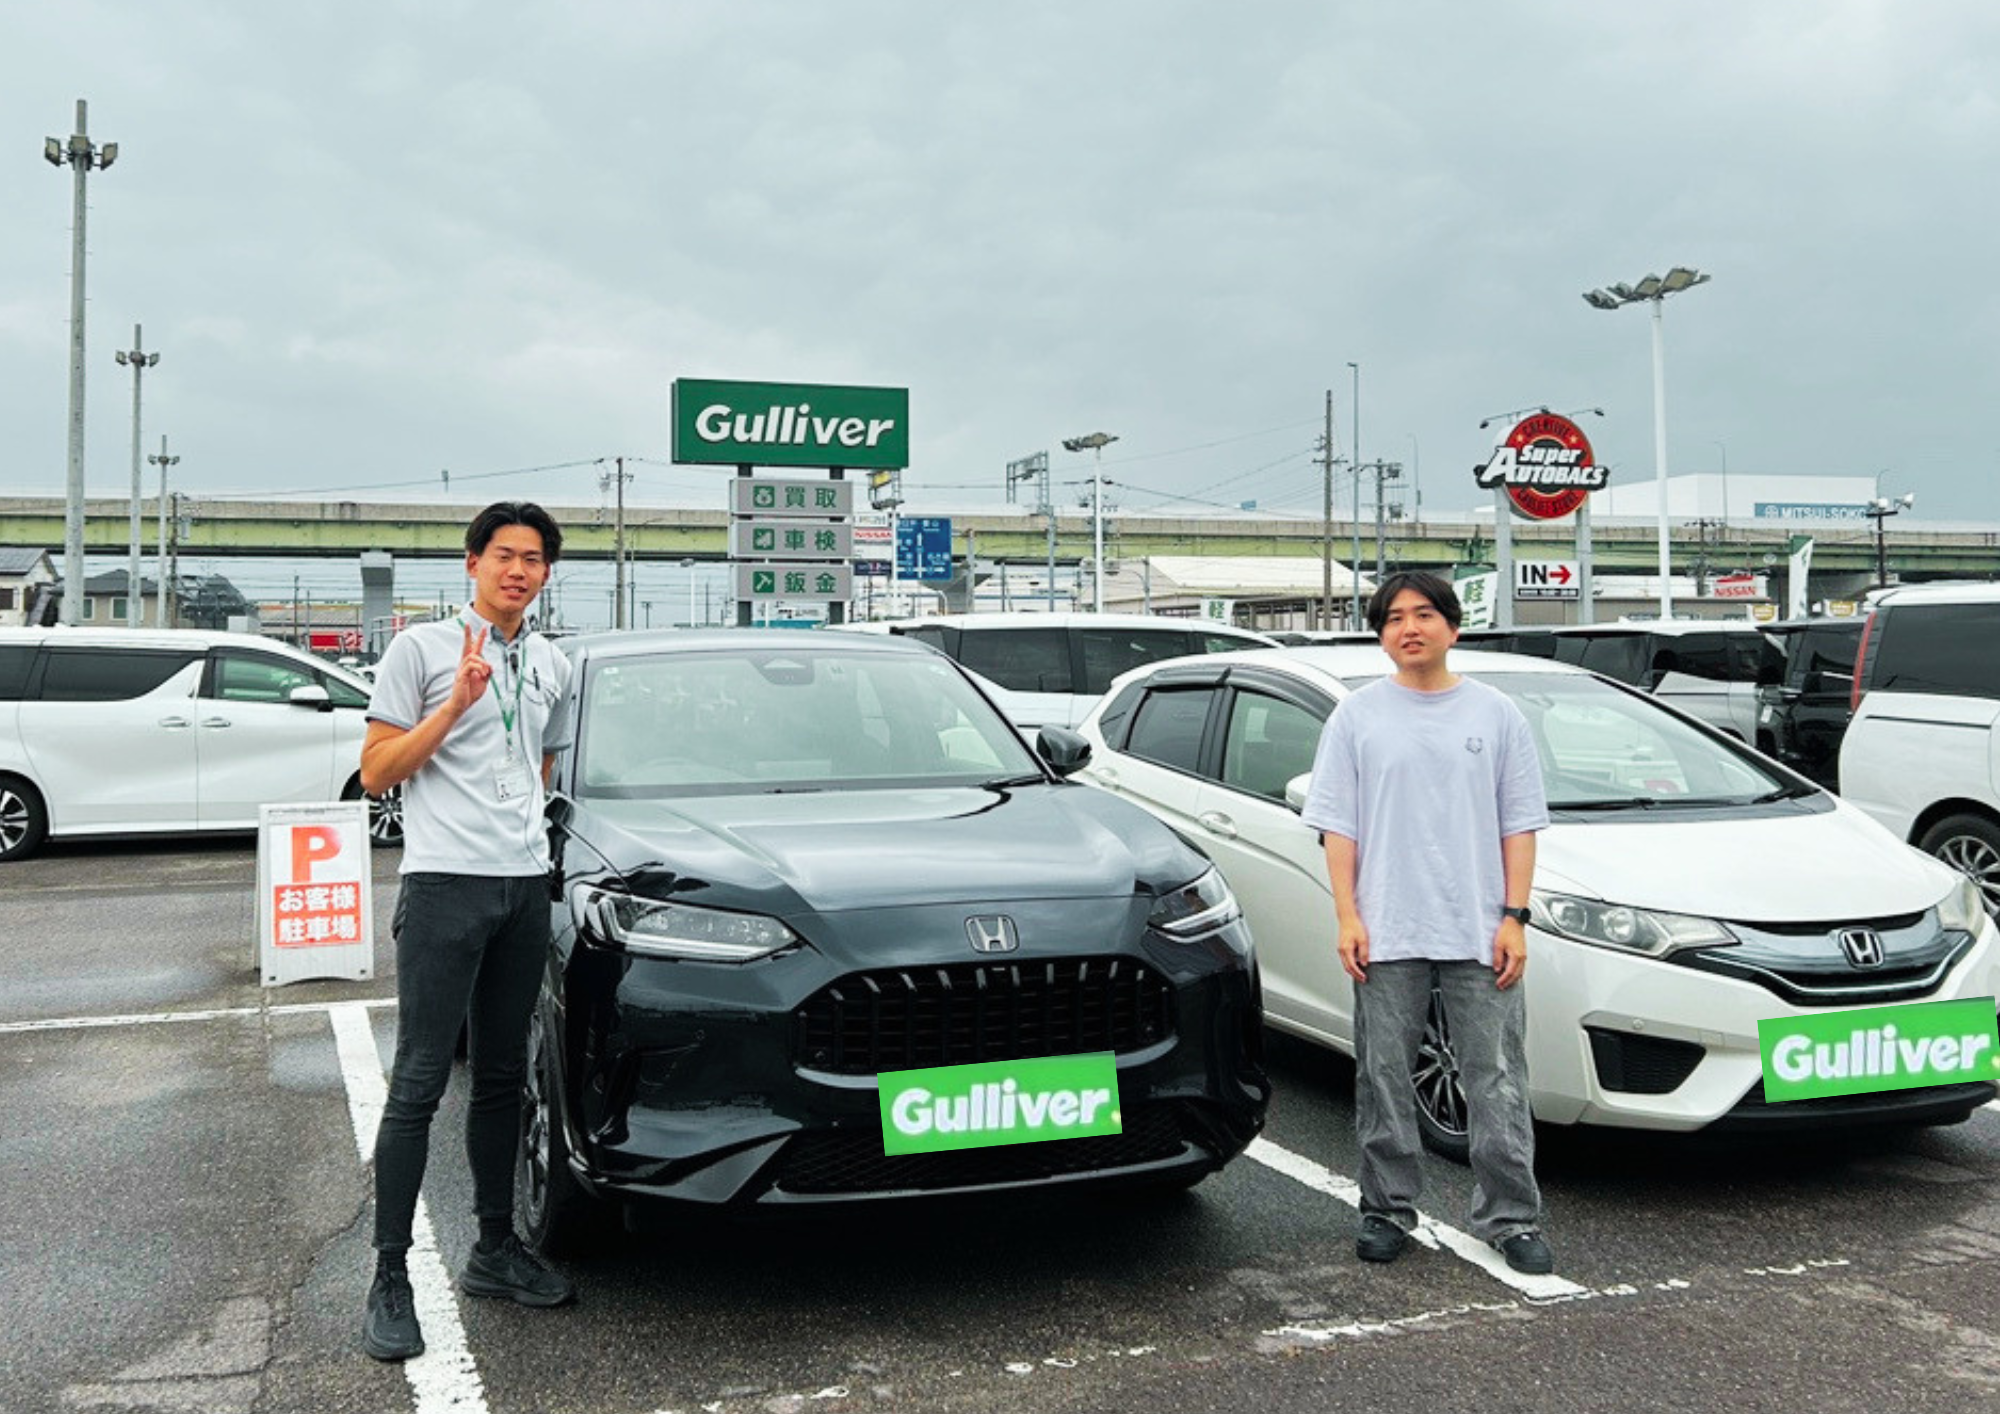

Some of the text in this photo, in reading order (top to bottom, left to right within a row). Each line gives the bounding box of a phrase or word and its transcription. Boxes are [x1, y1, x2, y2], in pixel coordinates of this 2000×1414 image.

[695, 403, 894, 446] Gulliver
[1480, 446, 1604, 485] AUTOBACS
[1520, 445, 1581, 465] Super
[783, 486, 837, 508] 買取
[783, 529, 837, 550] 車検
[783, 571, 837, 594] 鈑金
[1521, 564, 1547, 585] IN
[1714, 586, 1756, 598] NISSAN
[291, 826, 342, 883] P
[279, 884, 356, 913] お客様
[279, 914, 357, 943] 駐車場
